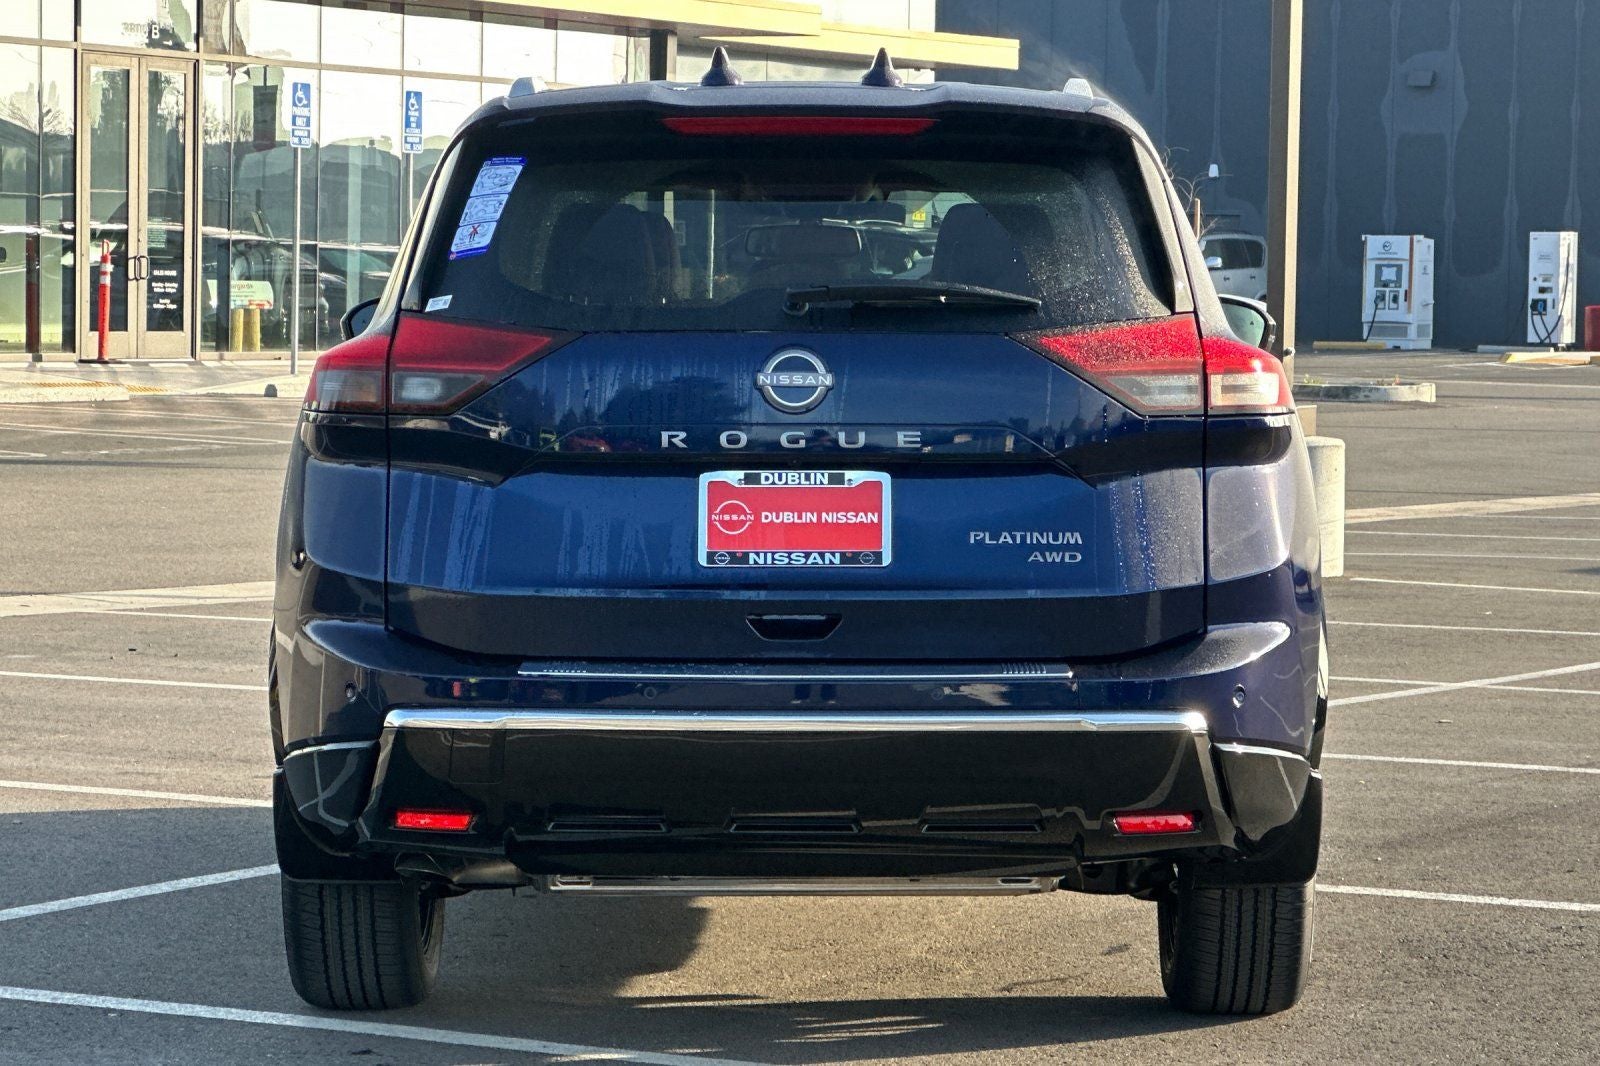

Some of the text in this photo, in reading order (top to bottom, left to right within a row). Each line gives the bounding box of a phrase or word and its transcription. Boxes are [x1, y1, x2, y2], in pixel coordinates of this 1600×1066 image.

[758, 373, 832, 386] NISSAN
[660, 430, 922, 449] ROGUE
[760, 472, 829, 485] DUBLIN
[761, 511, 879, 524] DUBLIN NISSAN
[968, 531, 1084, 545] PLATINUM
[748, 552, 841, 565] NISSAN
[1027, 551, 1083, 563] AWD
